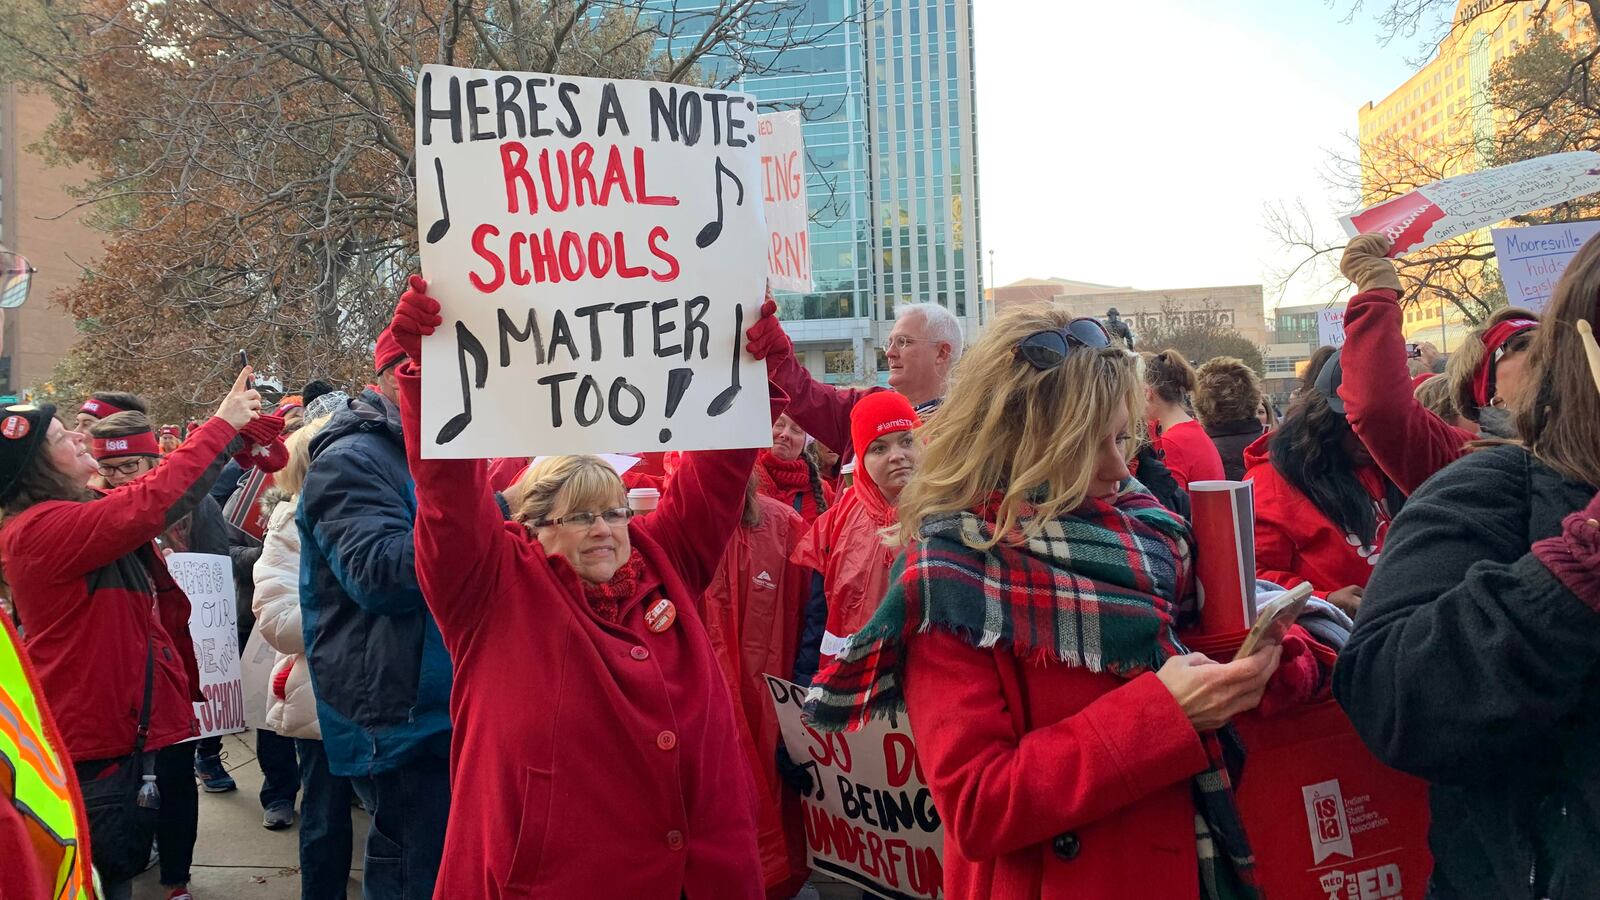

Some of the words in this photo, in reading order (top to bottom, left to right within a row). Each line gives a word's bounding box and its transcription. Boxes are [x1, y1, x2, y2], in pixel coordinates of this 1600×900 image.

[421, 71, 583, 146] HERE'S
[597, 82, 630, 137] A
[649, 86, 757, 148] NOTE:
[499, 141, 680, 215] RURAL
[468, 223, 680, 293] SCHOOLS
[1506, 229, 1582, 254] Mooresville
[497, 296, 710, 367] MATTER
[837, 774, 941, 833] BEING
[1357, 863, 1402, 900] ED
